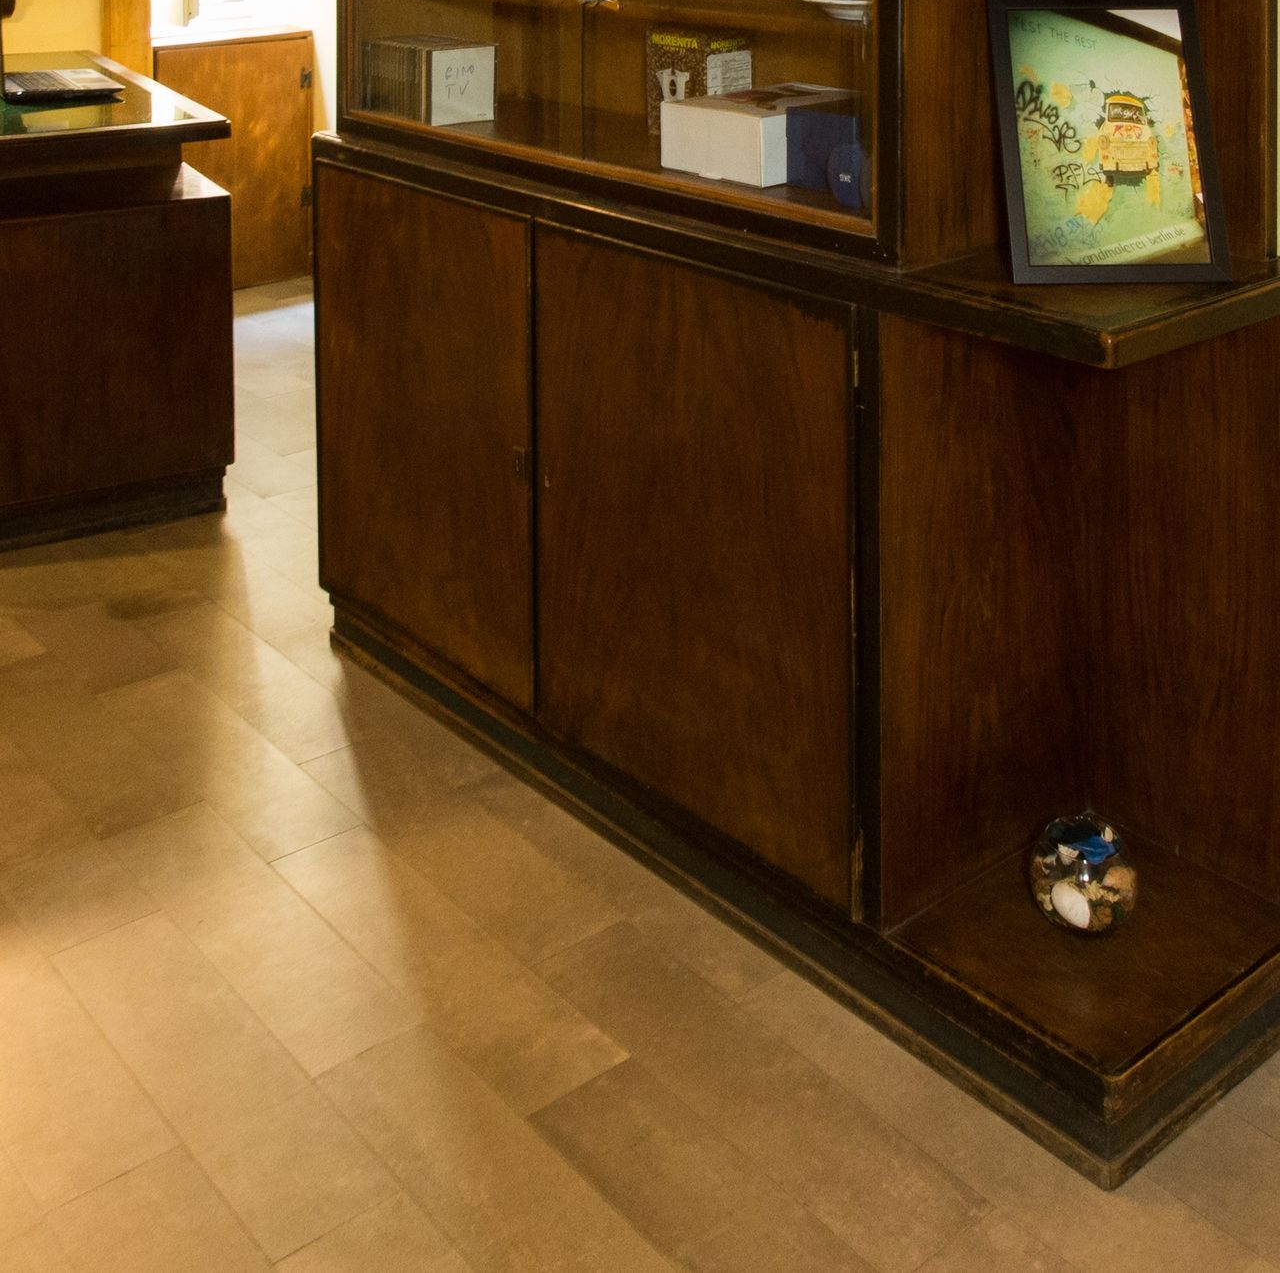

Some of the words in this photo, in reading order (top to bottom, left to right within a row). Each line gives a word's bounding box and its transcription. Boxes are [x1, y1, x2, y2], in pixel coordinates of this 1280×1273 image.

[651, 33, 699, 49] MORENITA
[1048, 27, 1070, 43] THE
[1074, 35, 1096, 50] REST
